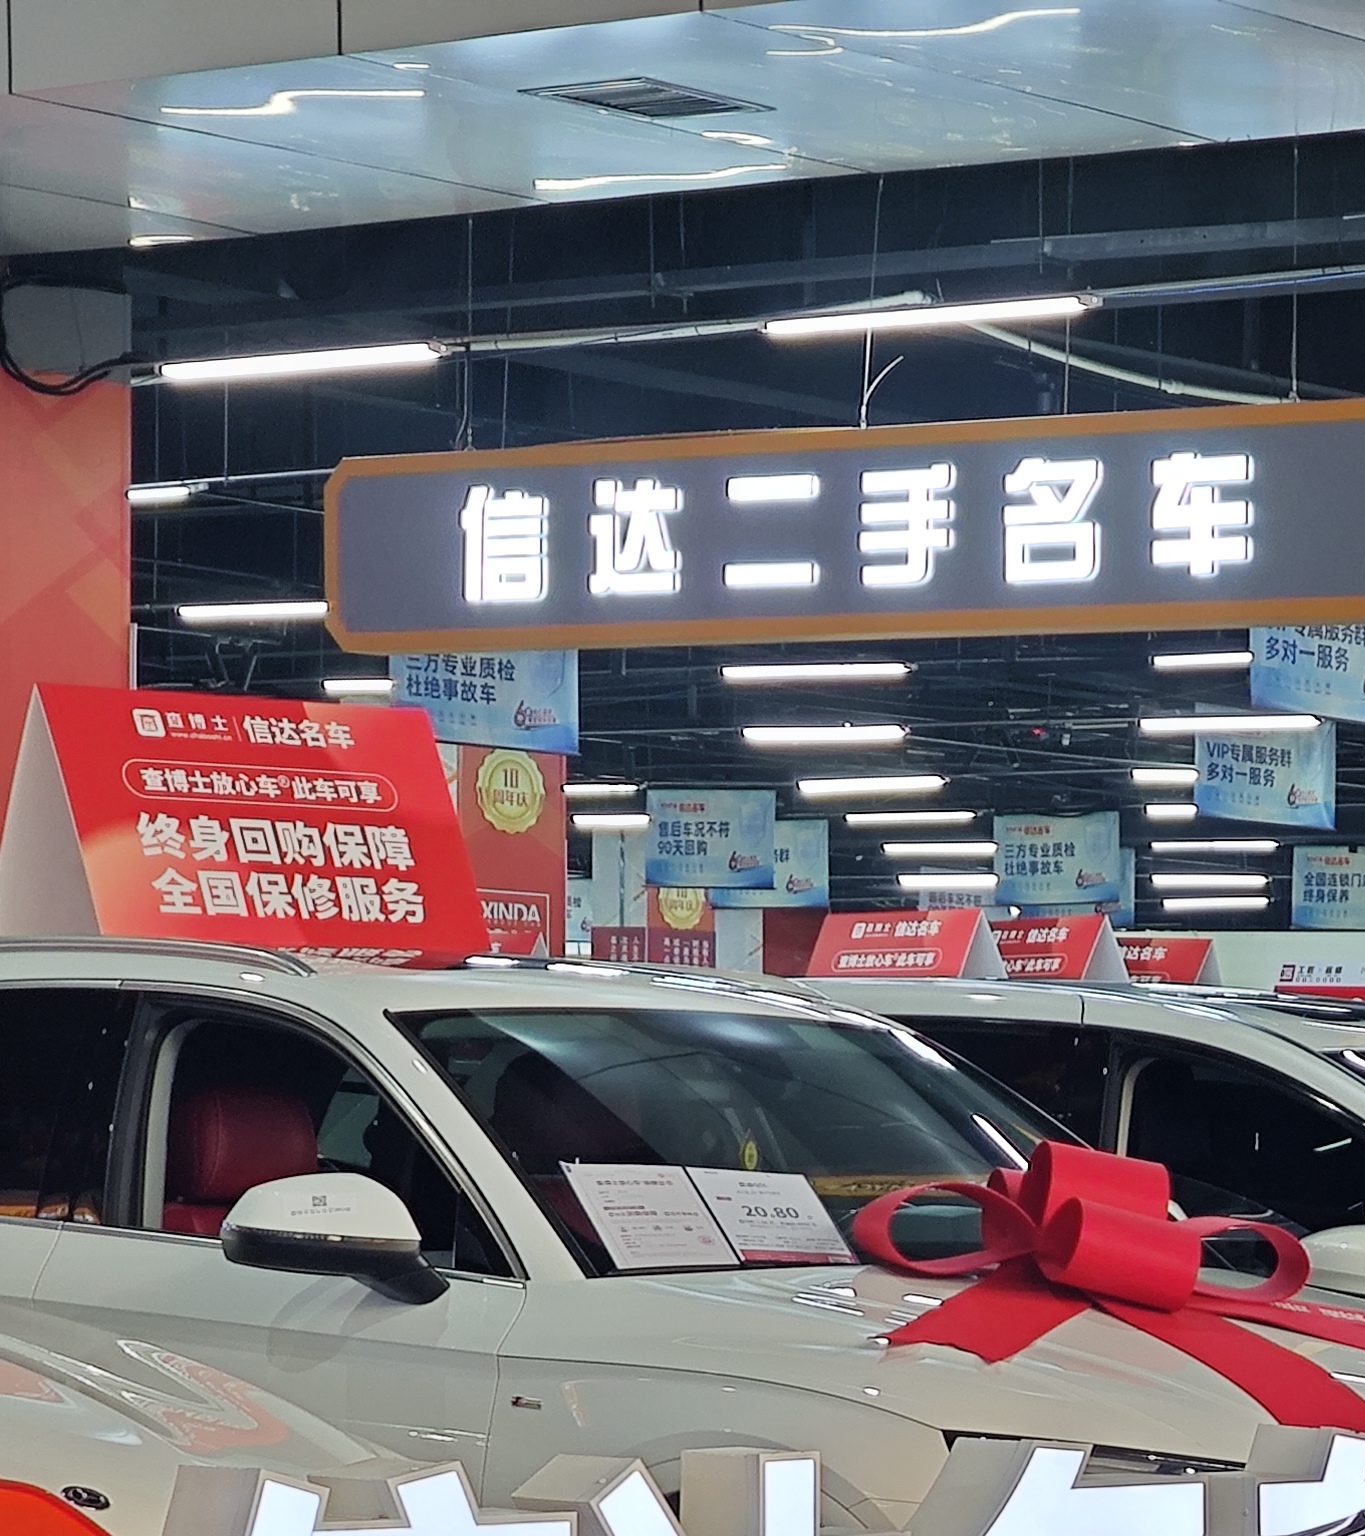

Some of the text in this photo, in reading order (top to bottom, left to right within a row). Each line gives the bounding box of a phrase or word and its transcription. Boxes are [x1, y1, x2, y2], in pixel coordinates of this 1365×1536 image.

[459, 453, 1254, 602] 信达二手名车
[1266, 636, 1349, 673] 多对一服务
[406, 674, 496, 705] 杜绝事故车
[167, 711, 355, 749] 查博士 信达名车
[1206, 741, 1293, 768] VIP专属服务群
[1206, 762, 1276, 787] 多对一服务
[136, 812, 416, 871] 终身回购保障
[658, 821, 730, 838] 售后车况不符
[657, 839, 708, 856] 90天回购
[1004, 842, 1076, 859] 三方专业质检
[1004, 860, 1064, 876] 杜绝事故车
[151, 867, 426, 924] 全国保修服务
[1303, 888, 1350, 903] 终身保养
[481, 900, 540, 922] XINDA
[741, 1205, 800, 1220] 20.80
